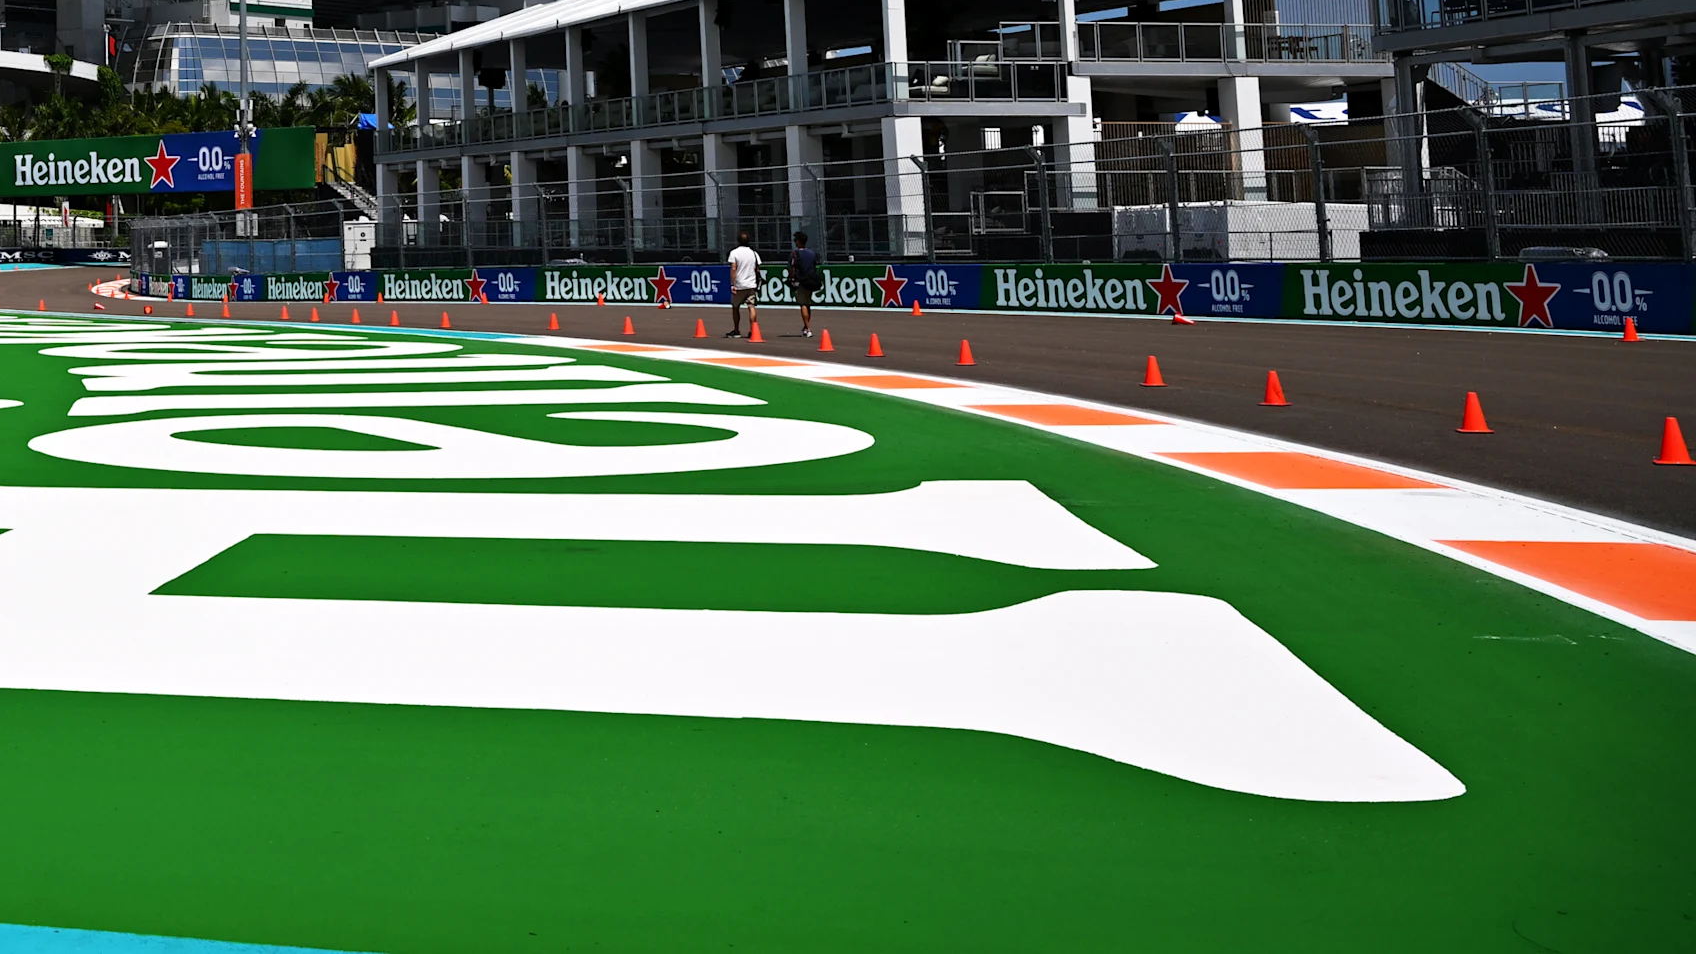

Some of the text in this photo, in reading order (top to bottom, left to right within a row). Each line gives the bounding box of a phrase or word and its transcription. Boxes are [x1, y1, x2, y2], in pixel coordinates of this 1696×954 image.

[14, 146, 231, 186] Heineken 0.0%
[0, 250, 54, 260] MSC
[191, 277, 228, 299] Heineken
[267, 276, 324, 300] Heineken
[383, 273, 465, 300] Heineken
[545, 270, 719, 300] Heineken 0.0%
[925, 268, 956, 296] 0.0%
[994, 268, 1251, 310] Heineken 0.0%
[1300, 268, 1648, 321] Heineken 0.0%
[1211, 304, 1244, 313] ALCOHOL FREE
[1593, 314, 1621, 326] ALCOHOL
